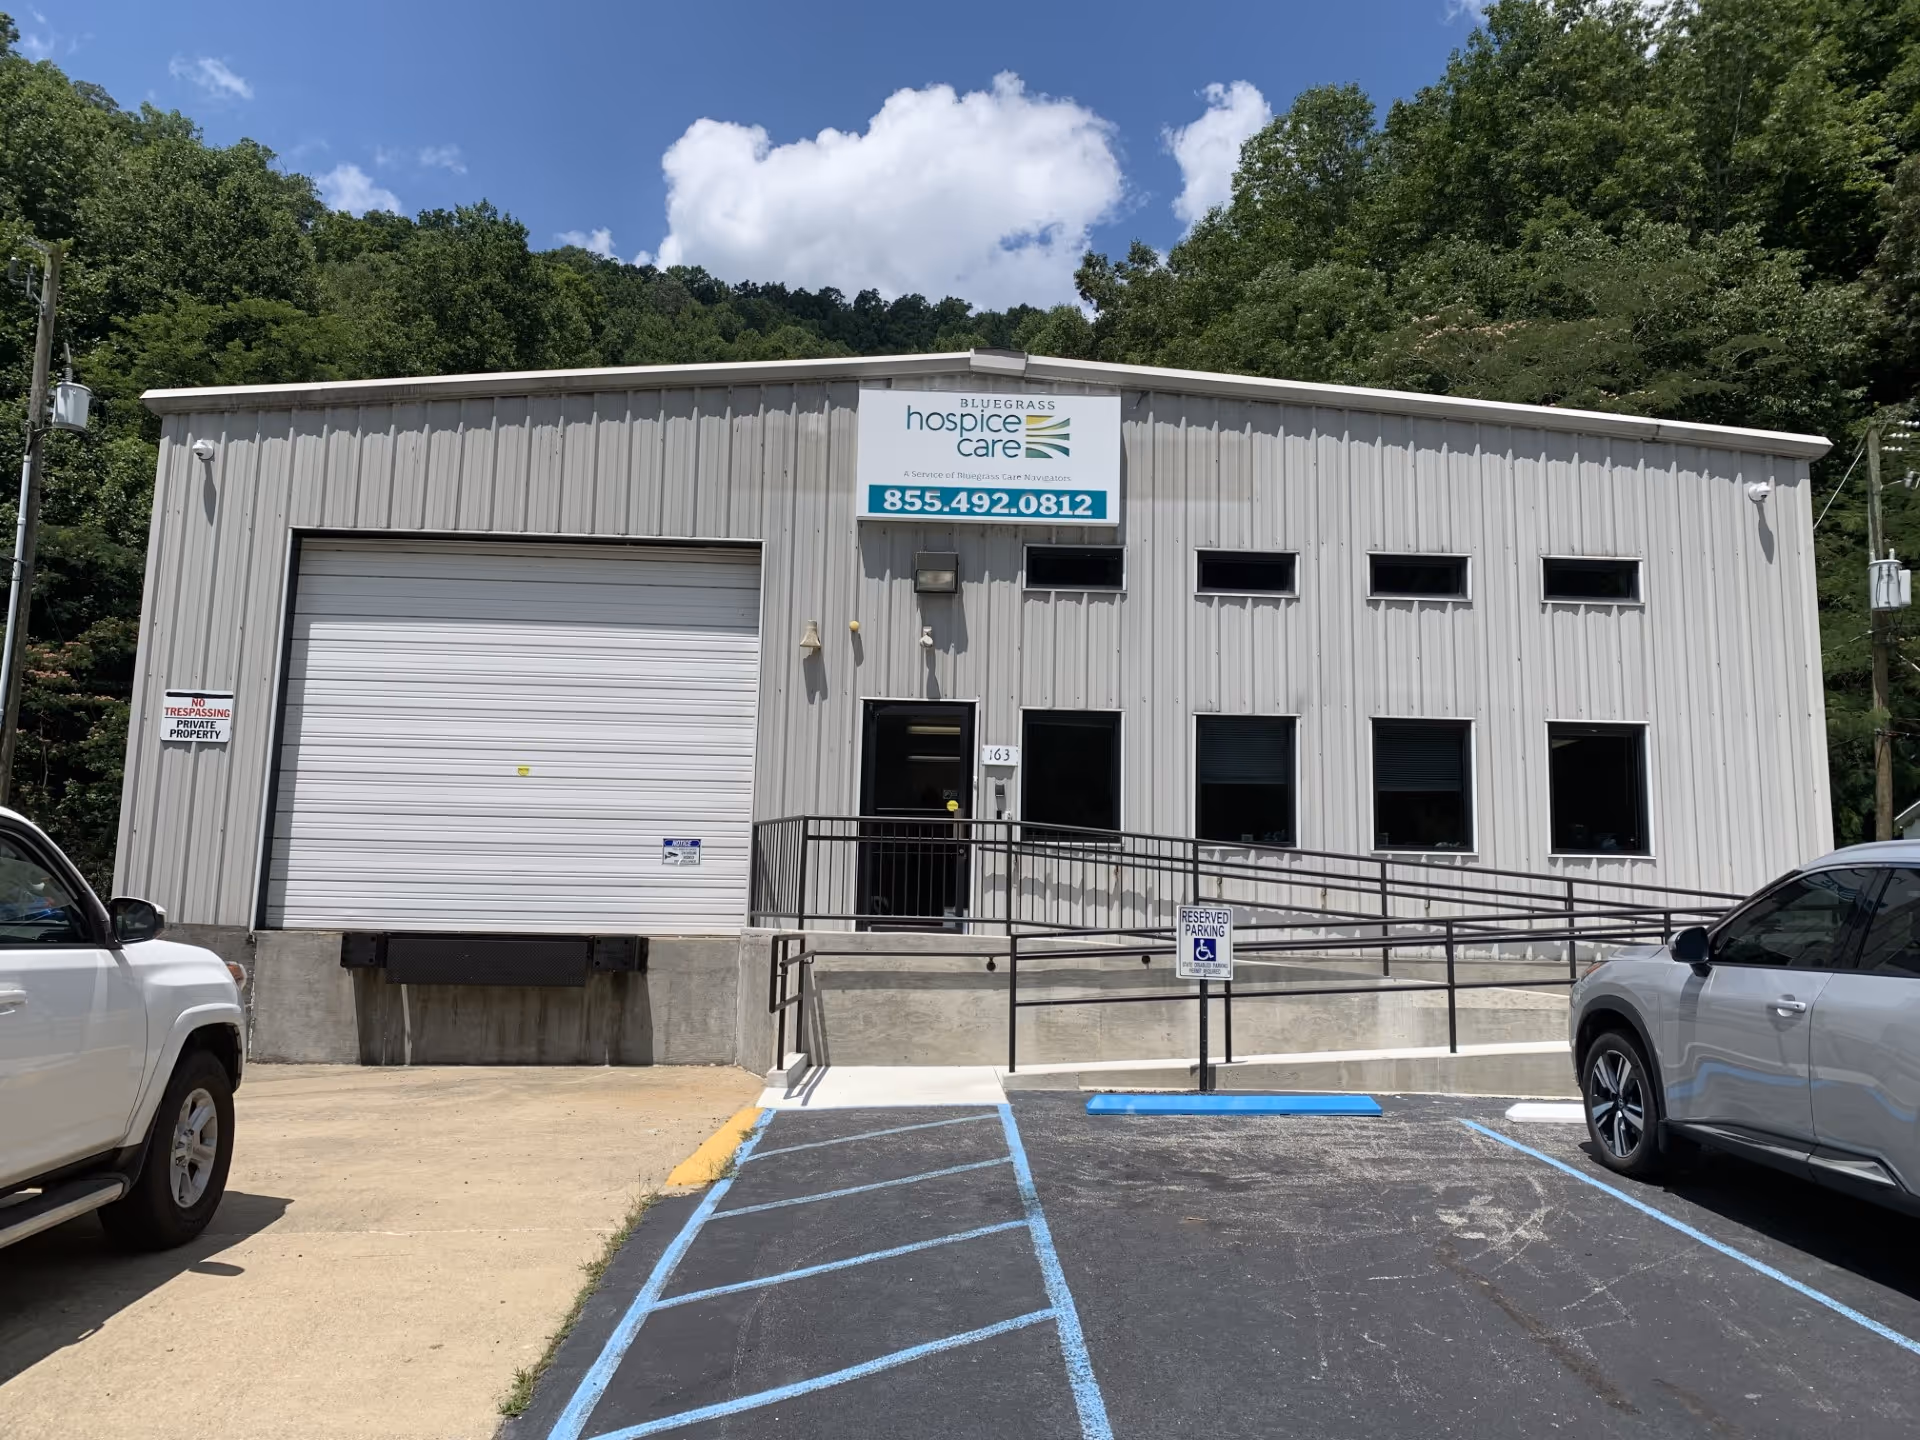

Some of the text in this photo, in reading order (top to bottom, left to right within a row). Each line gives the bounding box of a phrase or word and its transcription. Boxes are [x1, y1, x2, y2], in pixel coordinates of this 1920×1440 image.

[960, 398, 1055, 410] BLUEGRASS
[907, 405, 1022, 437] hospice
[957, 438, 1022, 458] care
[911, 470, 944, 479] Service
[945, 471, 955, 479] of
[957, 472, 1000, 481] Bluegrass
[1002, 473, 1022, 481] Care
[1024, 474, 1072, 482] Navigators
[883, 489, 1093, 516] 855.492.0812
[191, 698, 206, 707] NO
[164, 707, 231, 718] TRESPASSING
[176, 719, 217, 730] PRIVATE
[169, 729, 222, 739] PROPERTY
[989, 748, 1010, 761] 163
[1182, 910, 1229, 924] RESERVED
[1185, 924, 1225, 937] PARKING
